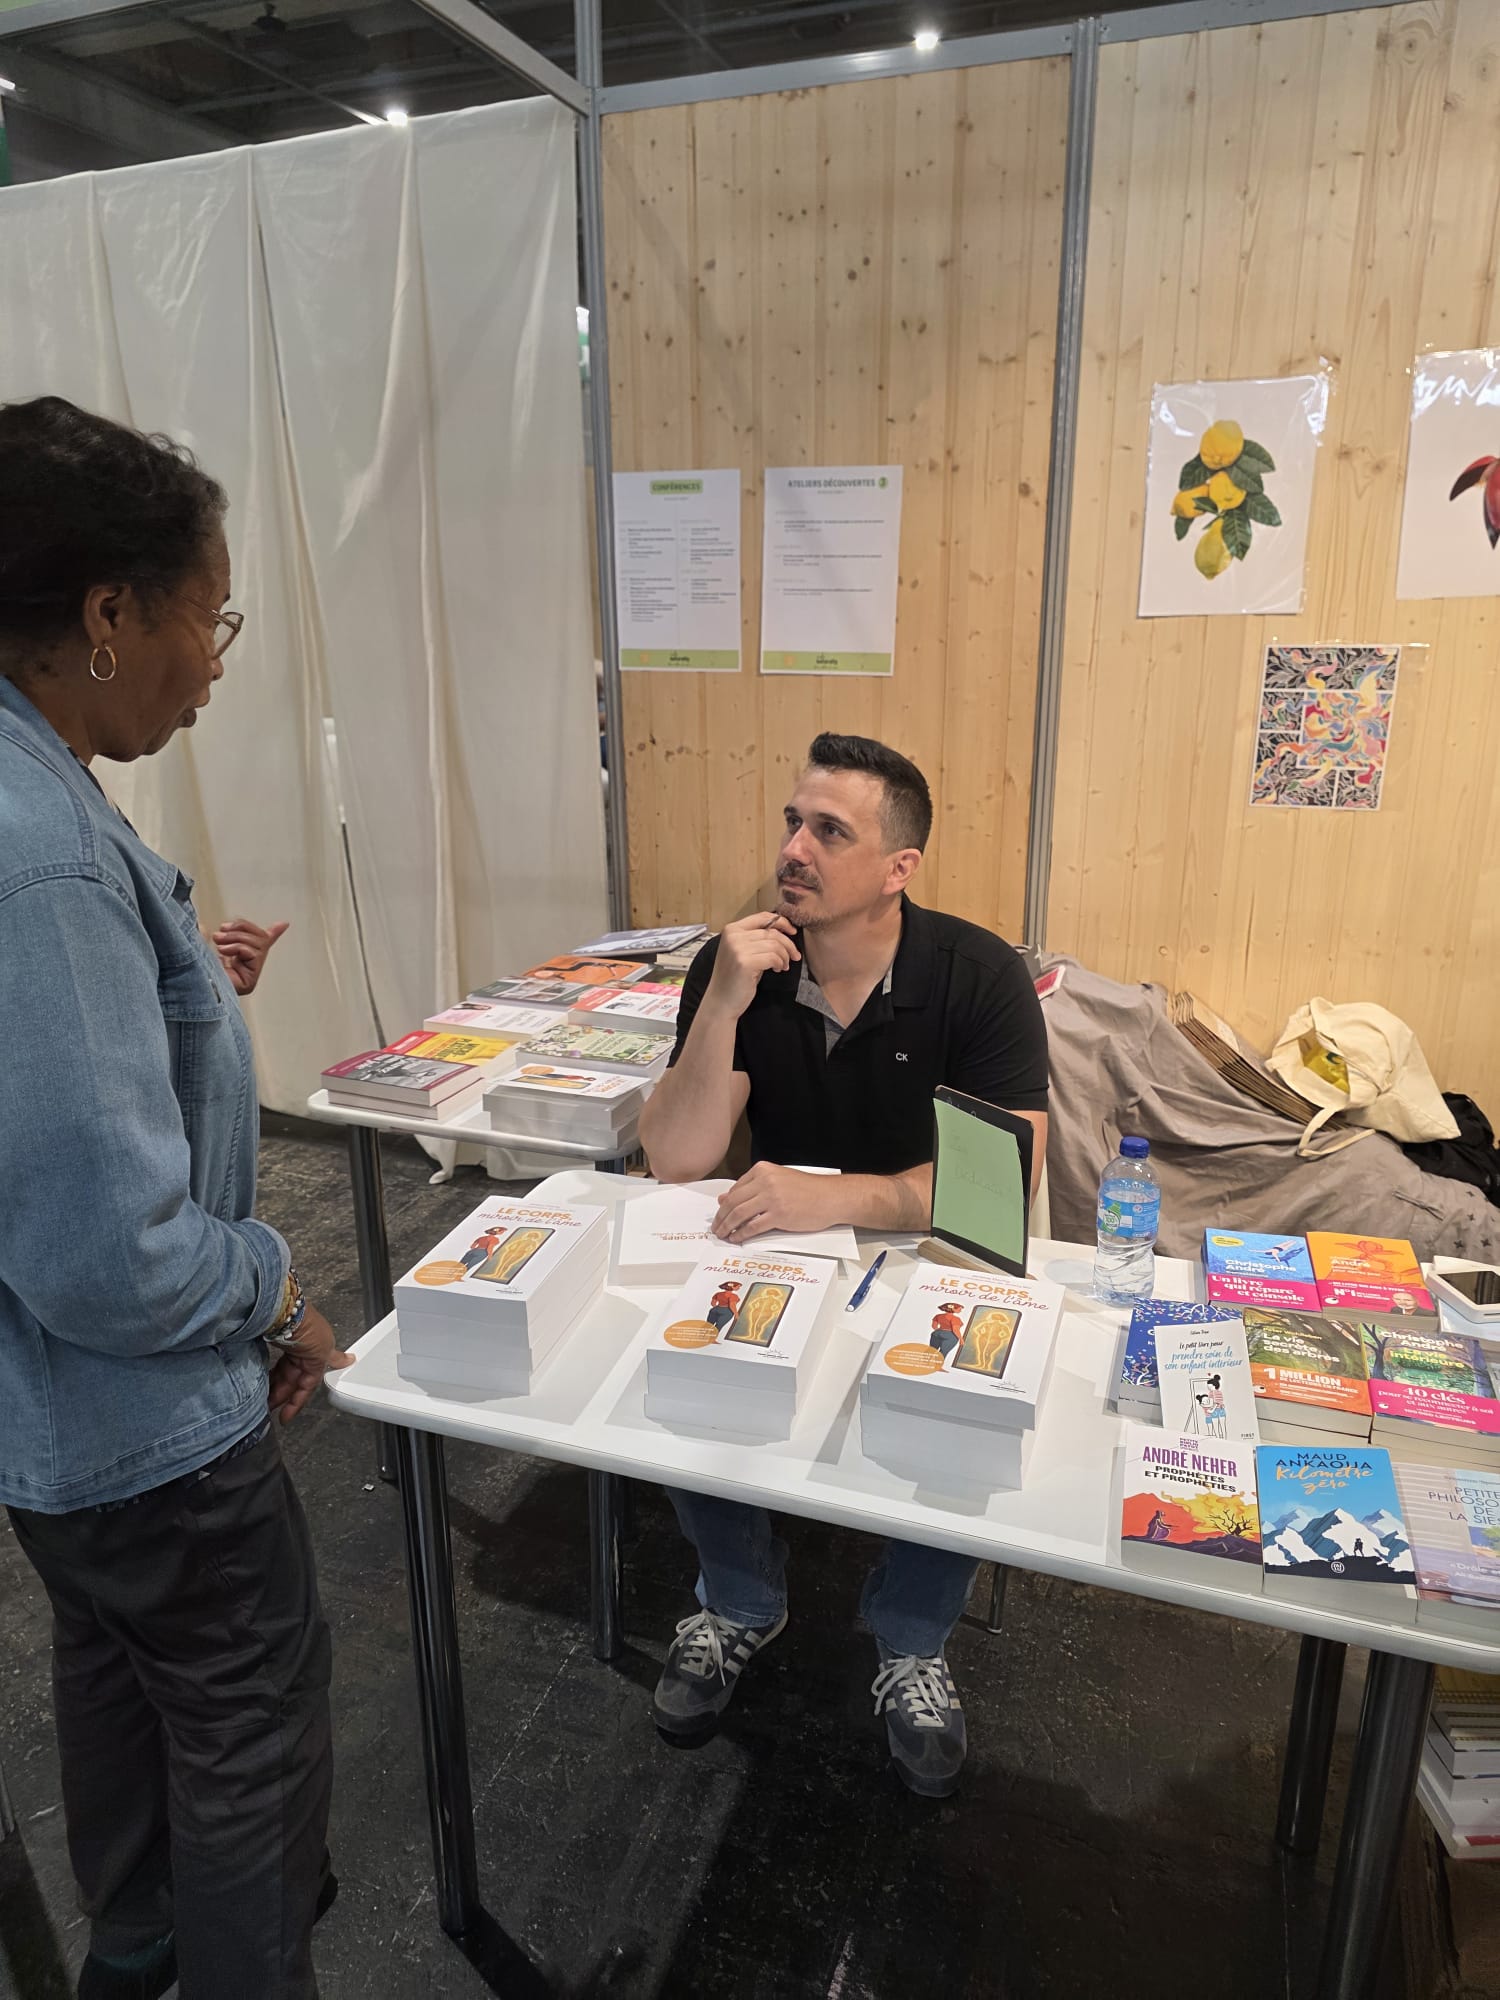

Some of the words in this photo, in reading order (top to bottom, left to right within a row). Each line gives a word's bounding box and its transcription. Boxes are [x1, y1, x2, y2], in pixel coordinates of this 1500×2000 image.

[652, 481, 700, 491] CONFÉRENCES
[788, 479, 822, 488] ATELIERS
[824, 477, 876, 488] DÉCOUVERTES
[896, 1052, 908, 1062] CK
[477, 1213, 521, 1222] miroir
[498, 1207, 516, 1215] LE
[518, 1209, 573, 1220] CORPS,
[723, 1258, 741, 1267] LE
[744, 1262, 806, 1276] CORPS,
[1224, 1259, 1296, 1272] Christophe
[1226, 1264, 1265, 1273] André
[1331, 1260, 1370, 1268] André
[704, 1265, 756, 1276] miroir
[757, 1269, 776, 1278] de
[778, 1272, 820, 1284] l'âme
[1233, 1276, 1264, 1286] livre
[940, 1278, 960, 1287] LE
[964, 1282, 1032, 1300] CORPS,
[1224, 1282, 1247, 1290] qui
[1249, 1284, 1294, 1296] répare
[1334, 1288, 1356, 1296] N°1
[919, 1284, 976, 1298] miroir
[979, 1292, 1000, 1302] de
[1003, 1295, 1049, 1310] l'âme
[1252, 1292, 1304, 1302] console
[1185, 1342, 1198, 1350] petit
[1210, 1340, 1224, 1349] pour
[1263, 1340, 1318, 1352] secrète
[1284, 1336, 1304, 1344] vie
[1382, 1331, 1464, 1348] Christophe
[1400, 1339, 1446, 1352] André
[1172, 1349, 1202, 1362] prendre
[1205, 1350, 1221, 1359] soin
[1224, 1346, 1233, 1358] de
[1264, 1345, 1290, 1354] des
[1292, 1348, 1340, 1362] arbres
[1426, 1350, 1447, 1358] vie
[1181, 1360, 1207, 1373] enfant
[1264, 1368, 1276, 1380] 1
[1280, 1369, 1341, 1386] MILLION
[1404, 1388, 1428, 1398] 40
[1431, 1392, 1466, 1404] clés
[1142, 1446, 1188, 1468] ANDRÉ
[1192, 1454, 1238, 1477] NEHER
[1276, 1460, 1372, 1470] ANKAOUA
[1276, 1466, 1374, 1480] Kilomètre
[1302, 1480, 1348, 1495] zéro
[1455, 1486, 1500, 1500] PETITE
[1428, 1492, 1499, 1508] PHILOSO
[1474, 1506, 1494, 1516] DE
[1449, 1512, 1468, 1521] LA
[1474, 1515, 1500, 1526] SIE
